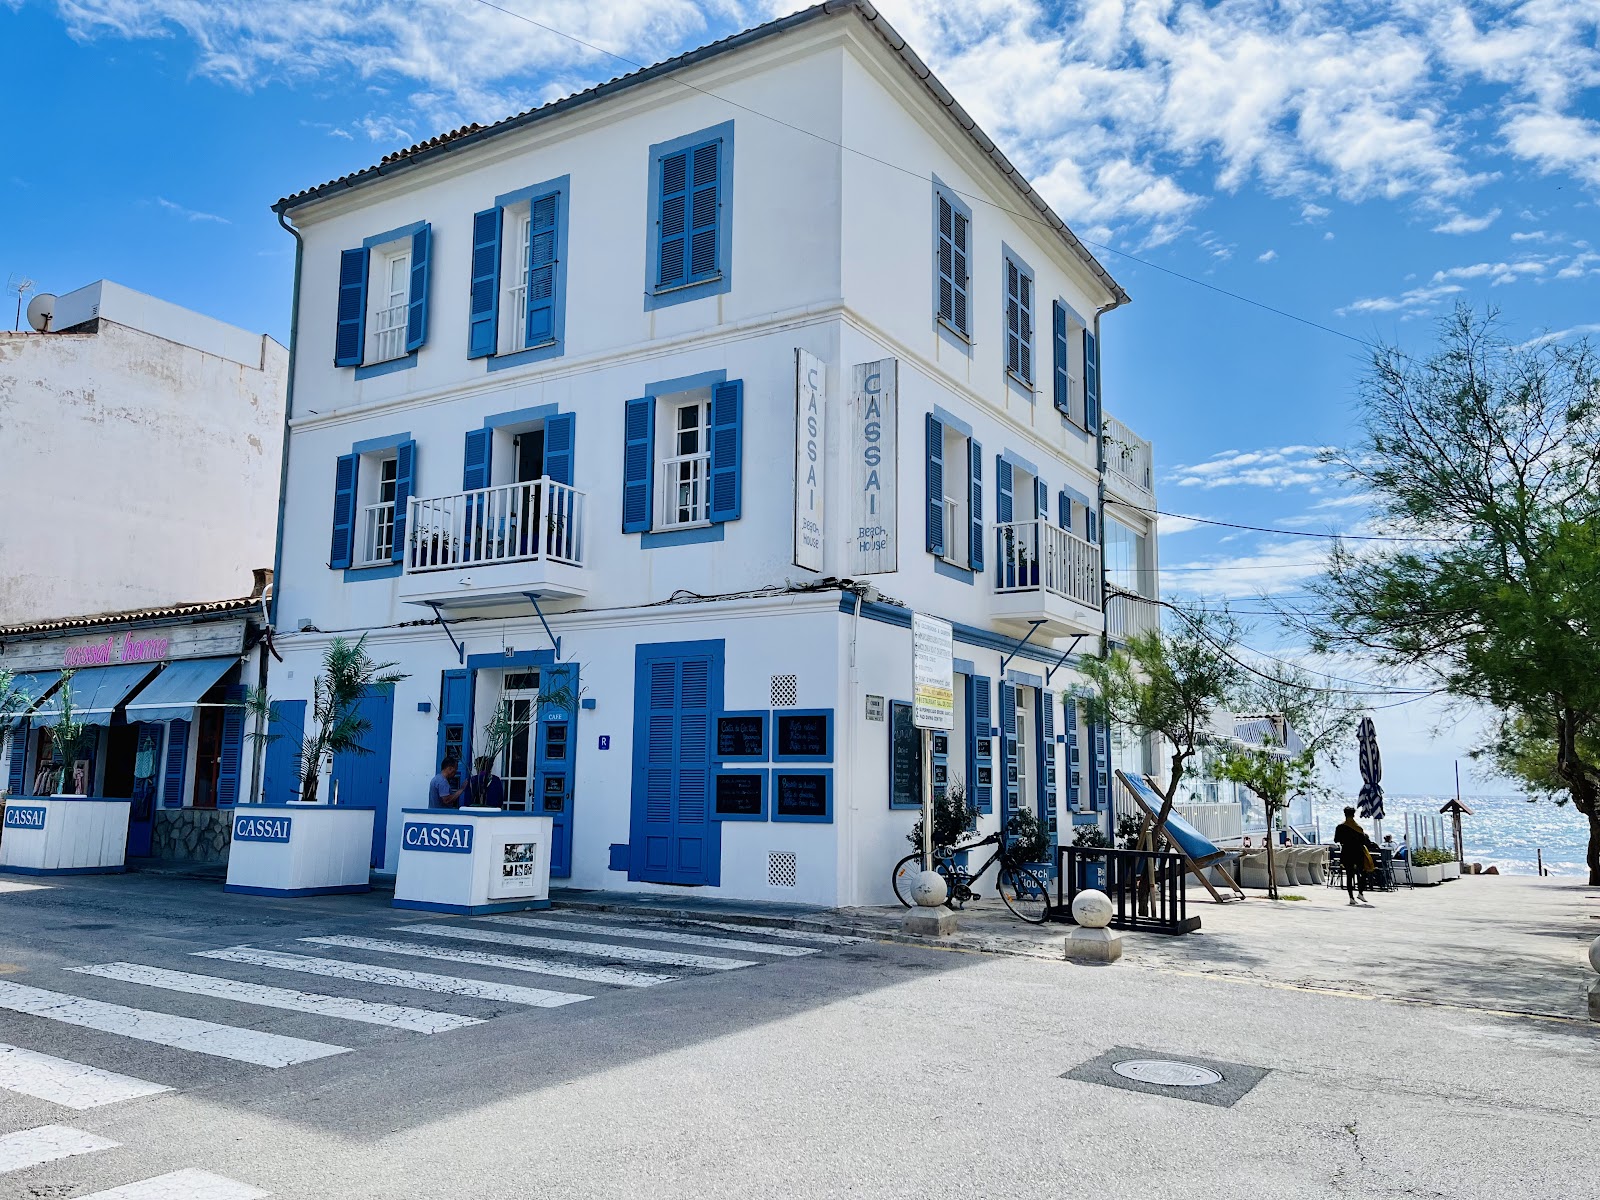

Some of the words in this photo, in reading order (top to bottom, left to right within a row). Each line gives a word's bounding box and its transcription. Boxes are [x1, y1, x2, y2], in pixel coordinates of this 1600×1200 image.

[806, 369, 818, 511] CASSAI
[864, 373, 881, 515] CASSAI
[121, 631, 168, 662] home
[505, 647, 513, 657] 21
[601, 737, 607, 746] R
[6, 808, 45, 827] CASSAI
[236, 819, 290, 839] CASSAI
[406, 826, 470, 850] CASSAI
